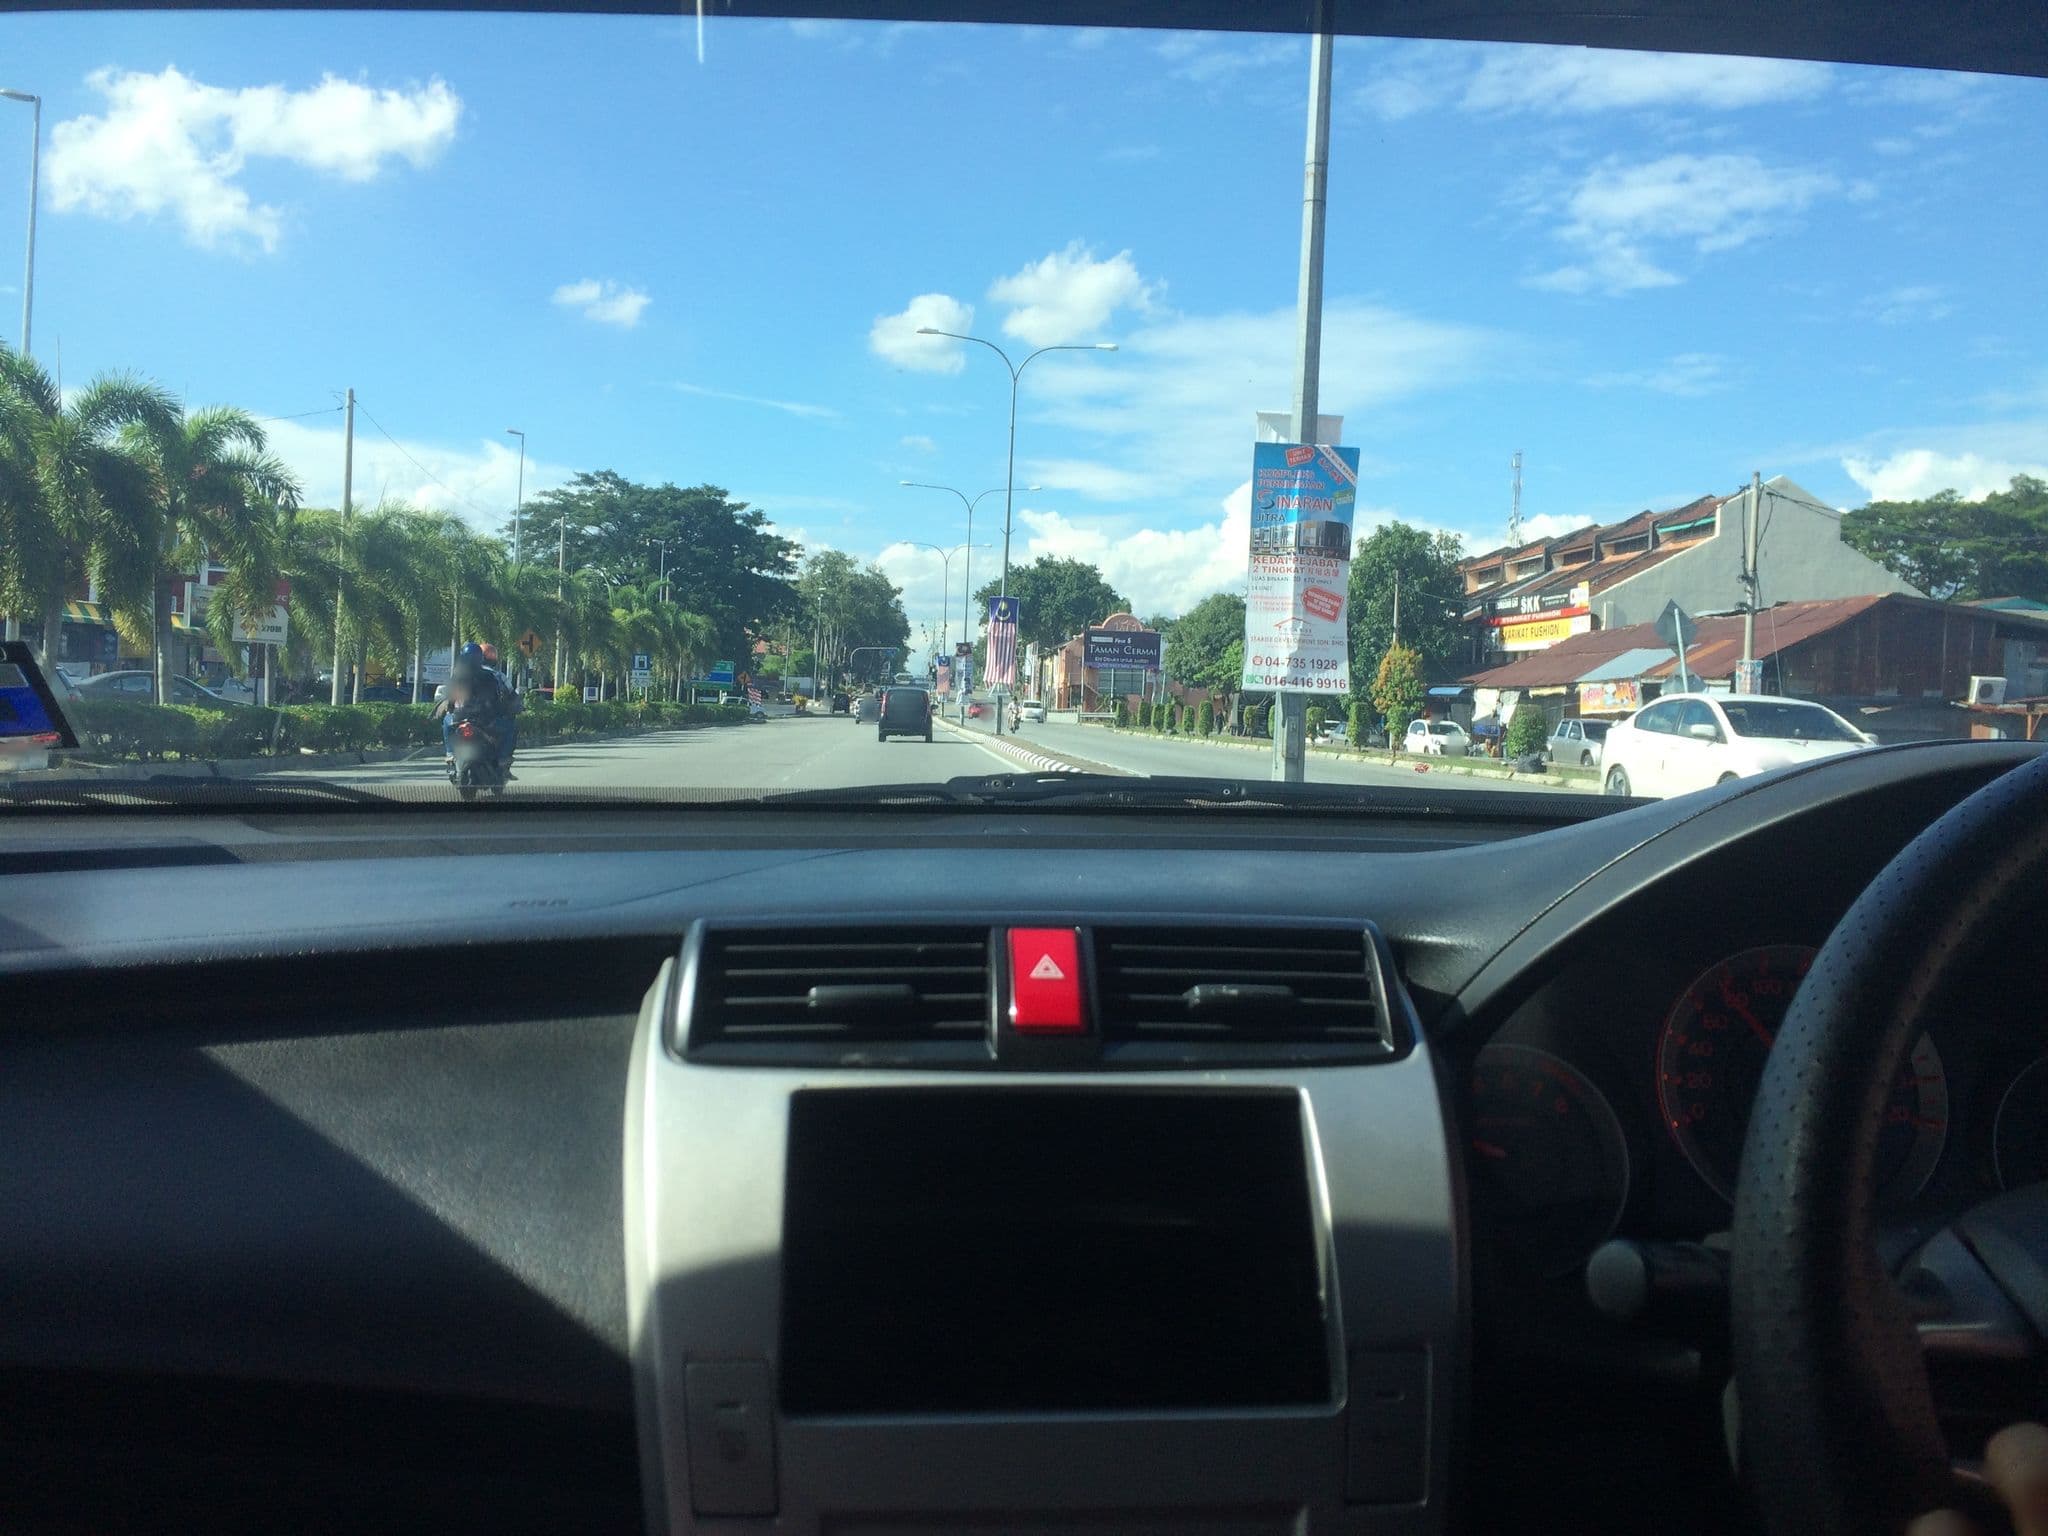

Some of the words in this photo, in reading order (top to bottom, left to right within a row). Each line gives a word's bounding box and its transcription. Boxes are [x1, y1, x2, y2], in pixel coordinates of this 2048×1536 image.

[1257, 512, 1286, 522] JITRA
[1253, 556, 1289, 565] KEDAI
[1292, 557, 1341, 568] PEJABAT
[1262, 566, 1305, 575] TINGKAT
[1520, 595, 1540, 614] SKK
[1089, 644, 1119, 655] TAMAN
[1123, 645, 1157, 656] CERMAI
[1265, 656, 1306, 670] 04-735
[1310, 658, 1338, 670] 1928
[1264, 674, 1314, 688] 016-416
[1316, 676, 1346, 689] 9916
